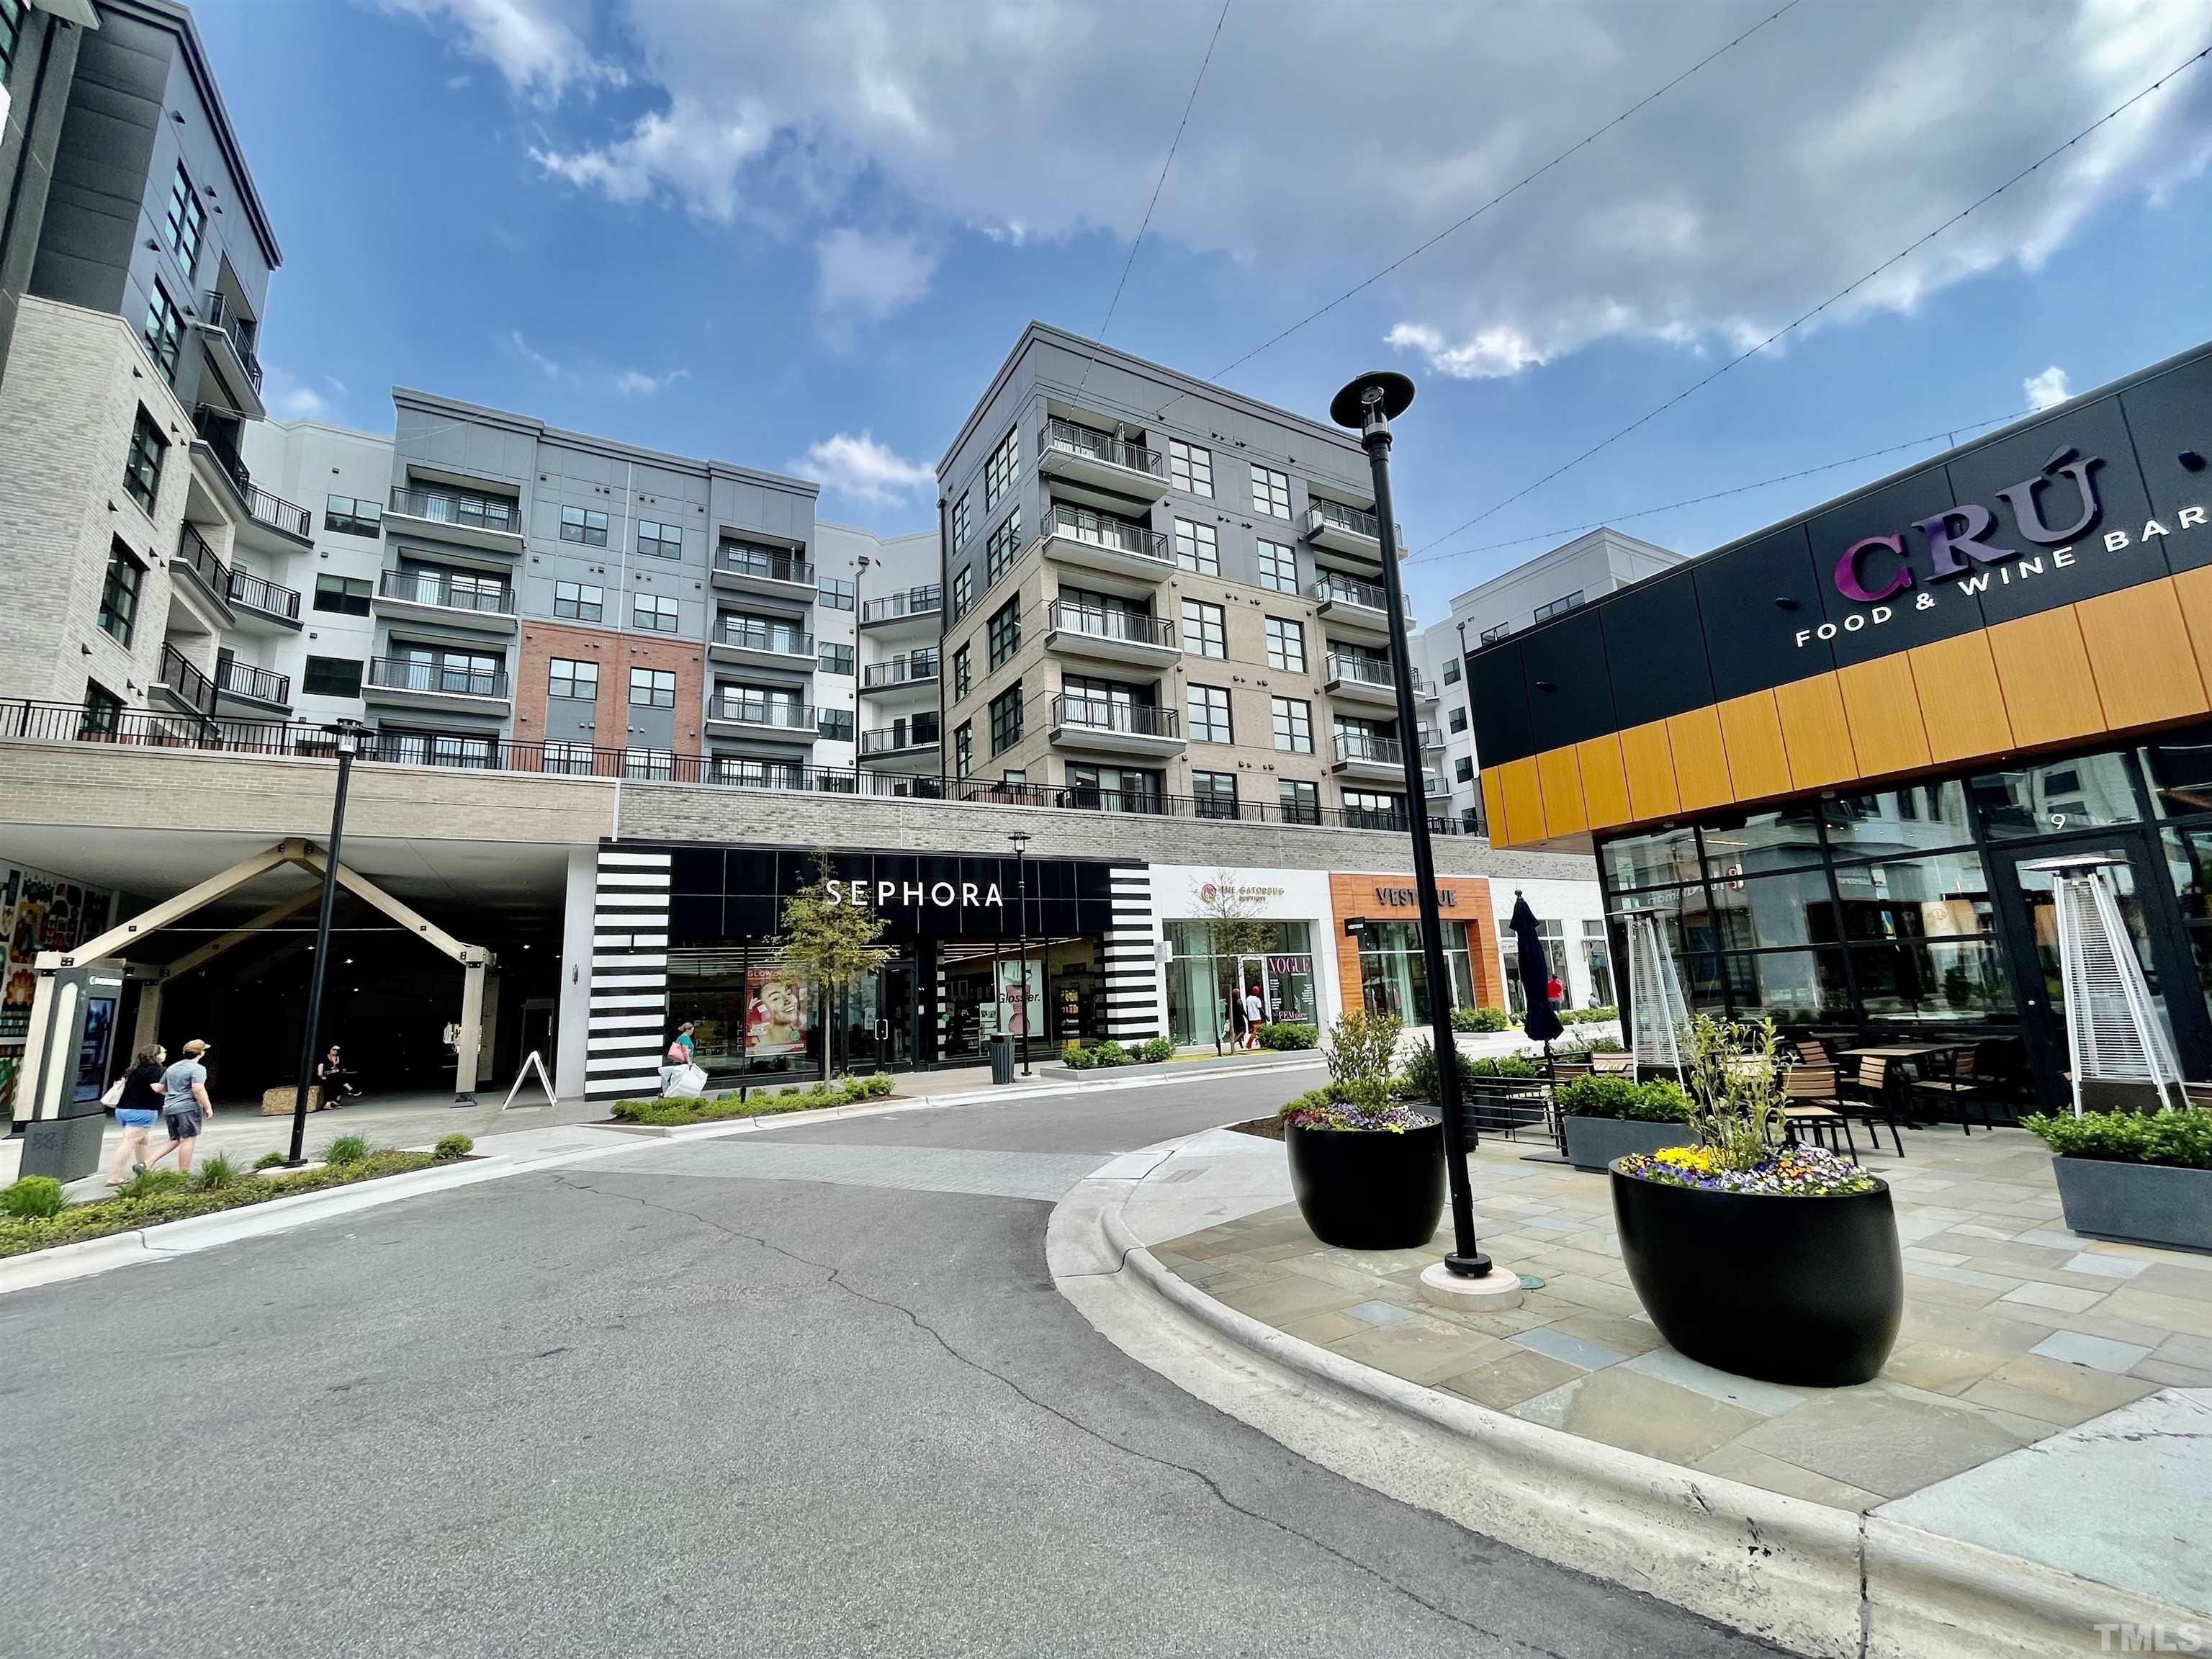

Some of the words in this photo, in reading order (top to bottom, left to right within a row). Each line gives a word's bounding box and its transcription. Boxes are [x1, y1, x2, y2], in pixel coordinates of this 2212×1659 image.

[1835, 444, 2099, 602] CRÚ
[1794, 606, 1892, 648] FOOD
[1915, 592, 1937, 611] &
[1957, 546, 2077, 597] WINE
[2103, 505, 2209, 553] BAR
[2051, 814, 2066, 830] 9
[826, 880, 1004, 907] SEPHORA
[1376, 887, 1458, 906] VESTUE
[1269, 957, 1310, 973] VOGUE
[999, 992, 1041, 1004] Gloser.
